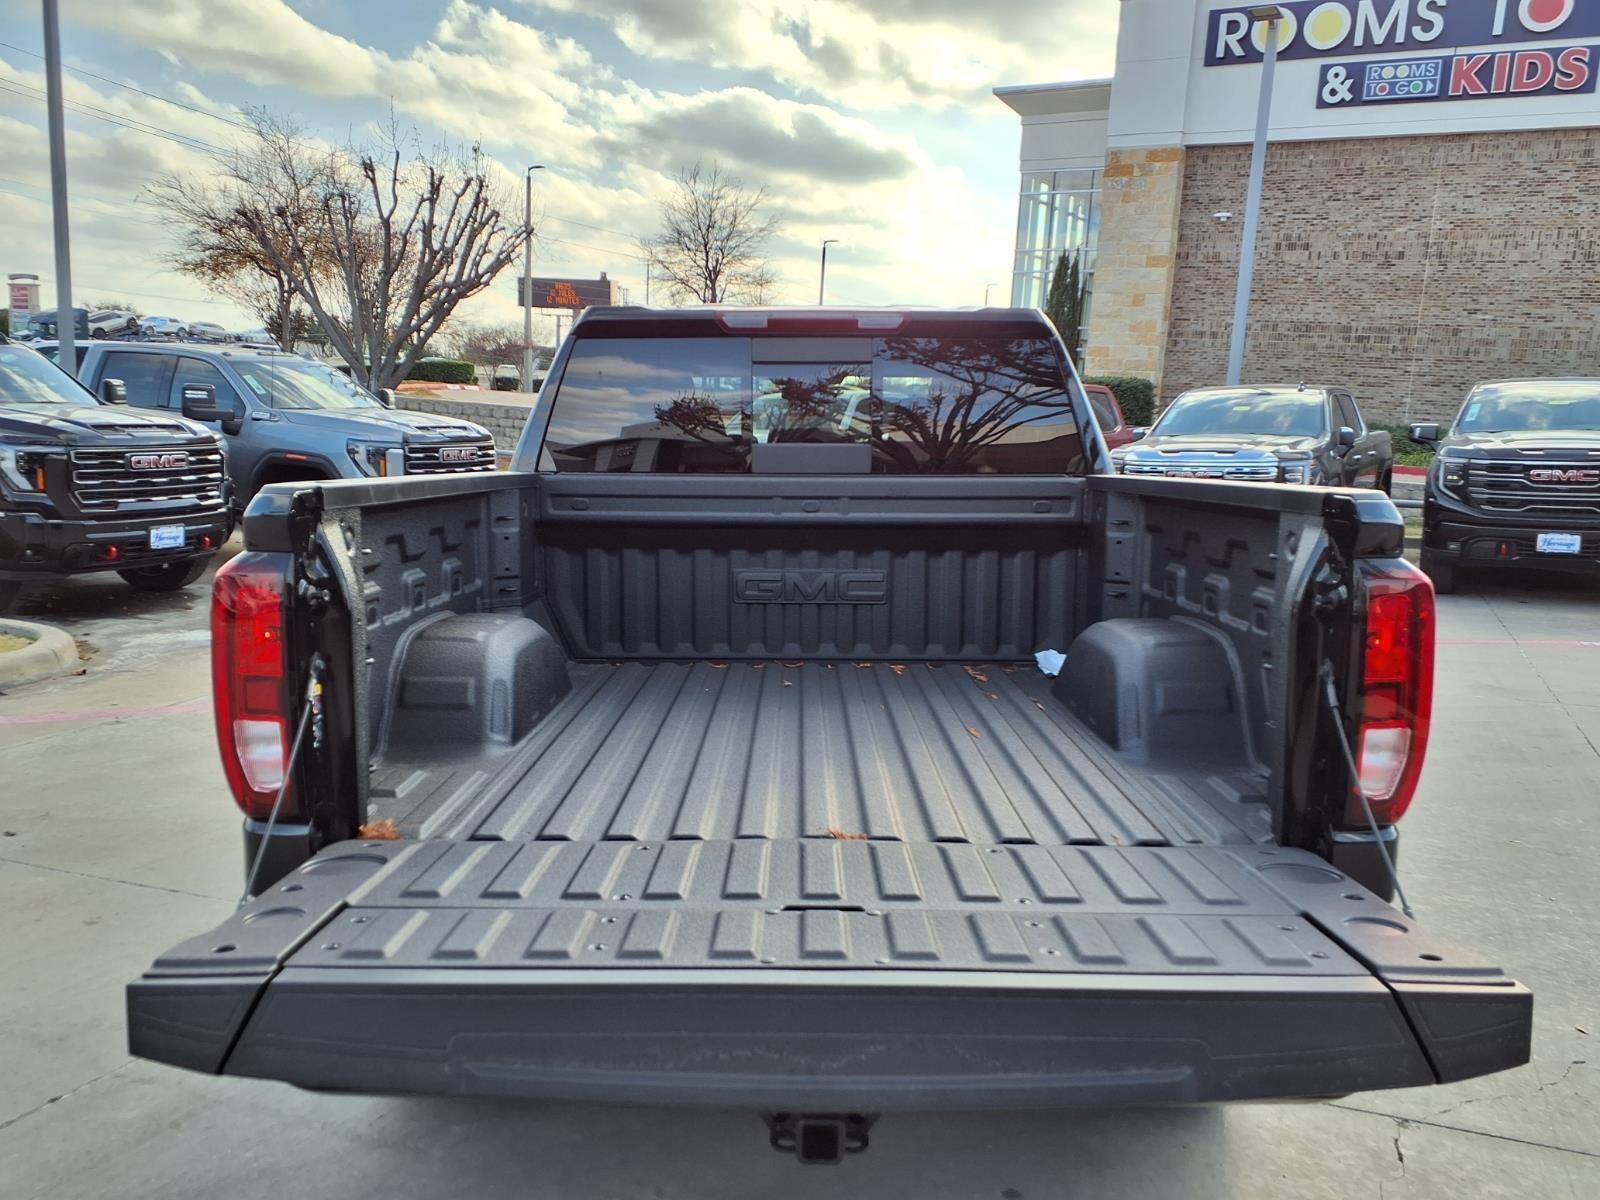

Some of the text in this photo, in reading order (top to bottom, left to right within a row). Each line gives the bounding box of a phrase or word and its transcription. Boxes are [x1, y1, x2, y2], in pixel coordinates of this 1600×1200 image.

[1216, 0, 1447, 58] ROOMS
[1370, 63, 1436, 80] ROOMS
[1448, 47, 1591, 96] KIDS
[1322, 66, 1353, 103] &
[1369, 80, 1423, 96] TO GO
[131, 454, 188, 469] GMC
[443, 449, 478, 461] GMC
[1530, 469, 1600, 482] GMC
[735, 572, 884, 601] GMC
